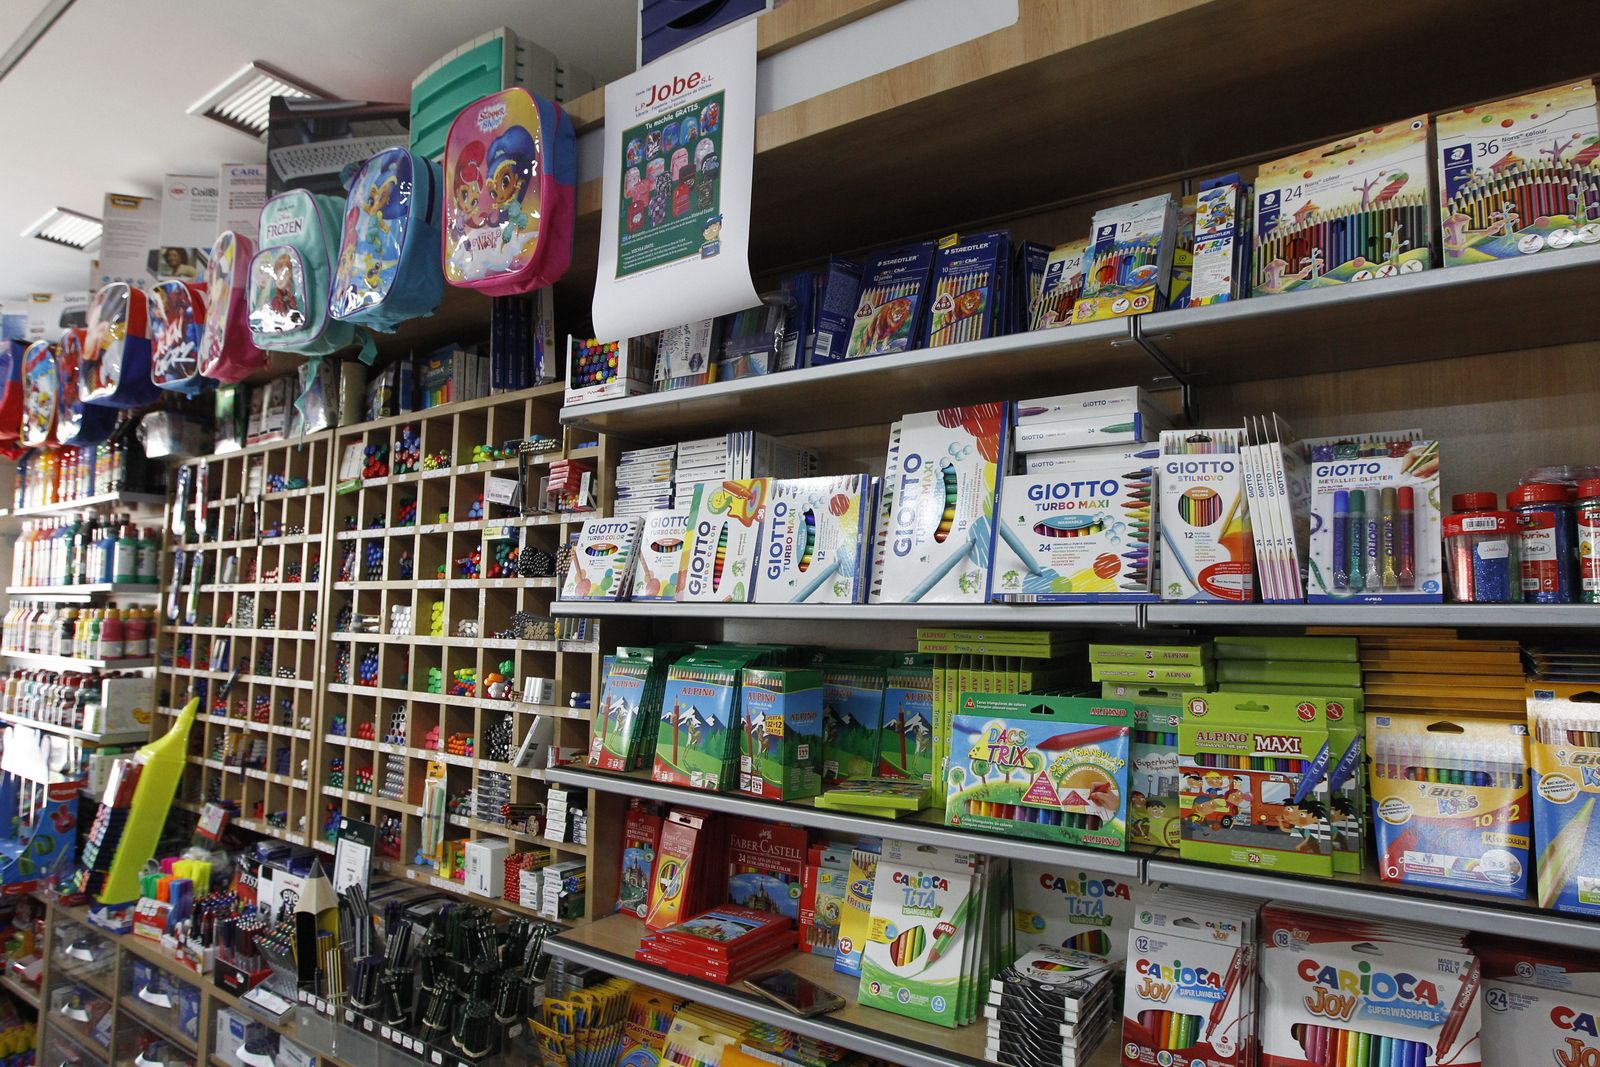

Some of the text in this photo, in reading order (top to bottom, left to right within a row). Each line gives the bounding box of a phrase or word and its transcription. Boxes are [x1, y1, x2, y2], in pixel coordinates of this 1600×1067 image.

[646, 71, 701, 107] Jobe
[1477, 127, 1548, 158] 36 colour
[1285, 184, 1302, 202] 24
[267, 220, 303, 240] FROZEN
[1119, 221, 1132, 234] 12
[949, 242, 990, 255] STAEDTLER
[882, 255, 918, 267] STAEDTLER
[1066, 258, 1080, 270] 24
[1083, 400, 1107, 408] GIOTTO
[1021, 433, 1044, 441] GIOTTO
[1031, 460, 1054, 469] GIOTTO
[1167, 461, 1235, 474] GIOTTO
[1317, 463, 1381, 477] GIOTTO
[921, 460, 934, 495] MAXI
[1276, 470, 1285, 495] GIOTTO
[1027, 479, 1119, 501] GIOTTO
[1246, 473, 1254, 498] GIOTTO
[1256, 473, 1264, 498] GIOTTO
[1266, 472, 1275, 497] GIOTTO
[893, 453, 922, 558] GIOTTO
[1035, 499, 1109, 512] TURBO MAXI
[588, 523, 628, 535] GIOTTO
[958, 519, 967, 532] 18
[706, 525, 717, 558] COLOR
[767, 501, 788, 580] GIOTTO
[783, 508, 796, 573] TURBO MAXI
[1184, 531, 1193, 539] 12
[1039, 543, 1051, 553] 24
[1267, 539, 1272, 547] 24
[689, 520, 711, 596] GIOTTO
[818, 551, 826, 562] 12
[904, 656, 914, 666] 36
[1163, 651, 1189, 659] ALPINO
[1165, 671, 1192, 679] ALPINO
[611, 680, 640, 689] ALPINO
[681, 687, 717, 697] ALPINO
[747, 691, 777, 703] ALPINO
[1090, 707, 1127, 717] ALPINO
[988, 728, 1027, 744] DACS
[1511, 725, 1527, 735] 12
[1196, 732, 1301, 754] ALPINO MAXI
[987, 745, 1031, 767] TRIX
[1050, 751, 1071, 773] CERA
[1071, 747, 1126, 770] TRIANGULAR
[730, 833, 801, 860] FABER-CASTELL
[1081, 834, 1121, 848] ALPINO
[738, 854, 746, 863] 24
[1249, 853, 1260, 864] 24
[936, 922, 957, 935] MAXI
[841, 939, 852, 951] 12
[1137, 938, 1149, 951] 12
[1277, 932, 1289, 946] 18
[1437, 957, 1453, 967] MADE
[1437, 963, 1461, 975] ITALY
[1518, 964, 1533, 977] 24
[870, 982, 880, 993] 12
[1137, 976, 1173, 1002] JOY
[1179, 987, 1196, 998] SUPER
[1304, 985, 1441, 1023] JOY SUPERWASHABLE
[1487, 991, 1508, 1009] 24
[1127, 1044, 1139, 1057] 12
